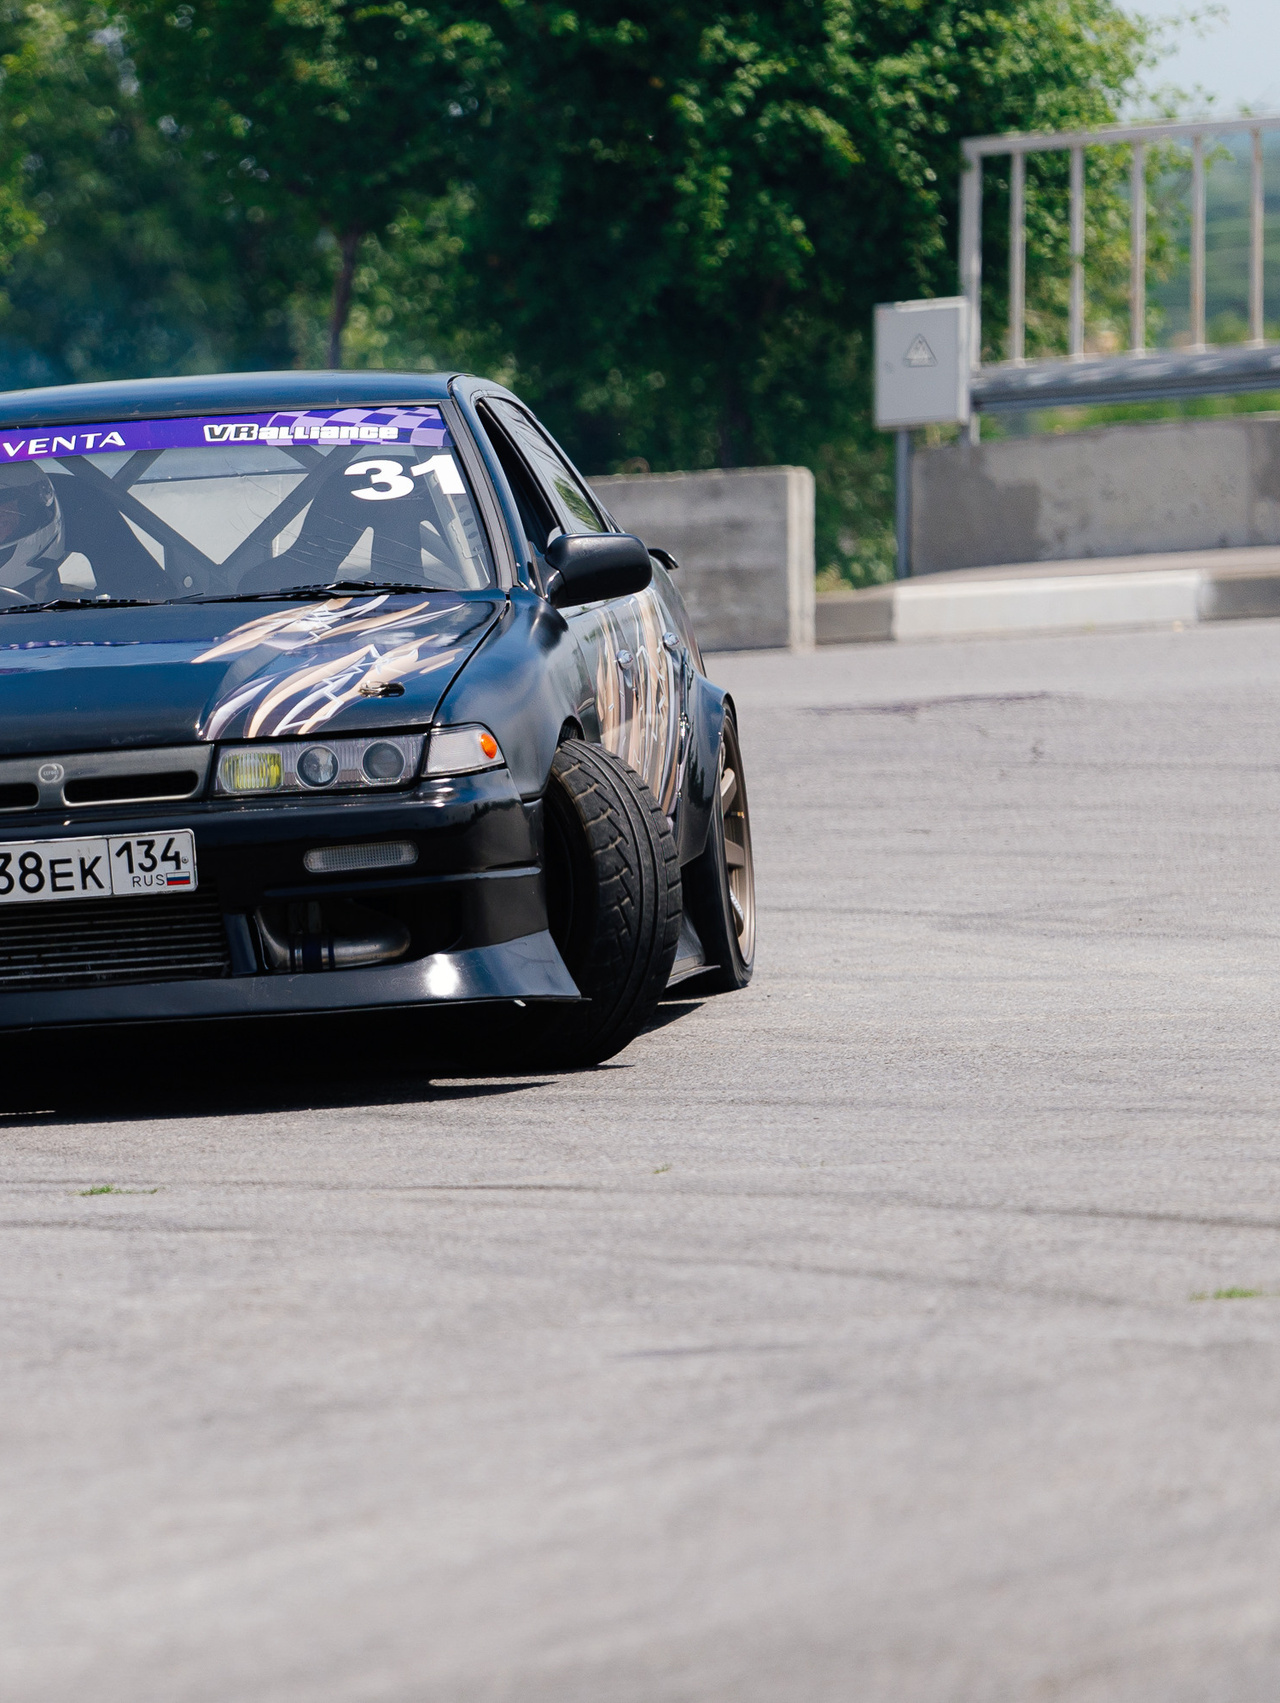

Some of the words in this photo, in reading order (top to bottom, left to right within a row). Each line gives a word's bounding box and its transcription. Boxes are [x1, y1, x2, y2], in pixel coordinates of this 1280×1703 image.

[344, 454, 466, 500] 31
[115, 837, 182, 874] 134
[132, 873, 165, 888] RUS
